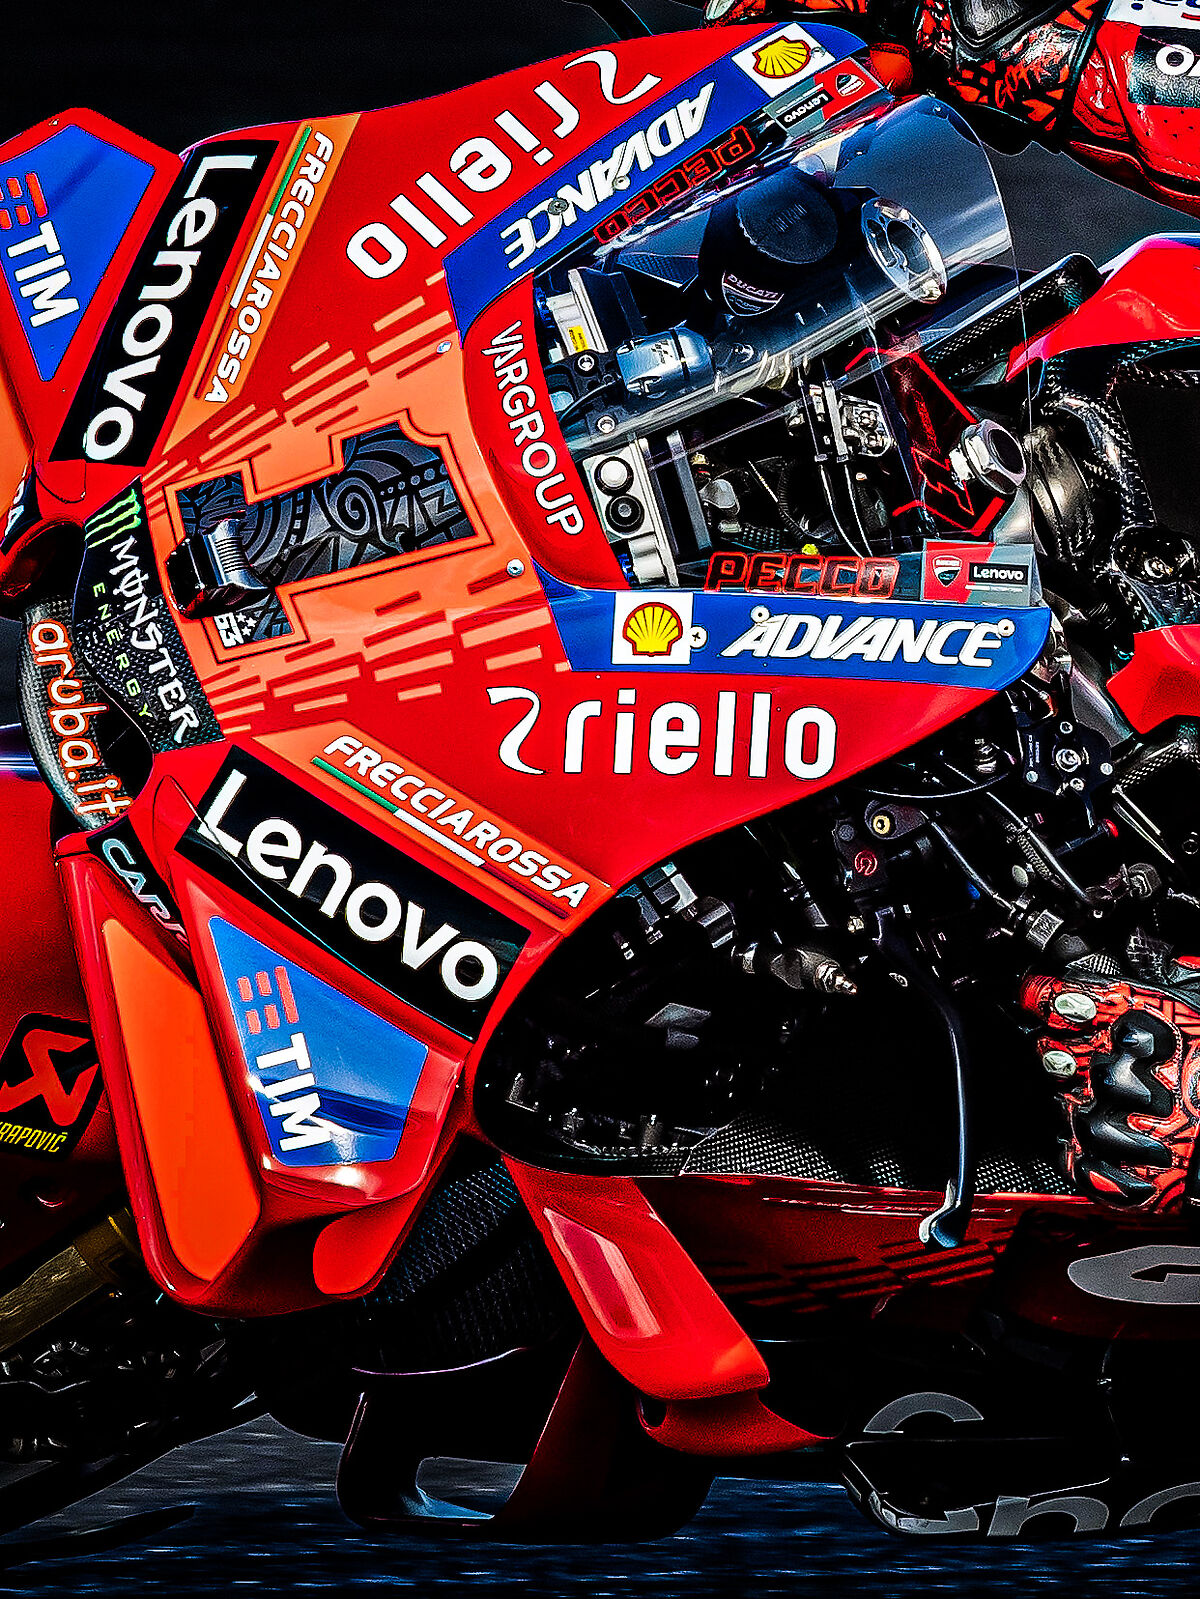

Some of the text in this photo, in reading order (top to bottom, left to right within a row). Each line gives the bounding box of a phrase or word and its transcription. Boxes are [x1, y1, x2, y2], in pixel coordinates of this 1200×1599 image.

[783, 93, 829, 124] Lenovo
[346, 80, 580, 280] riello
[500, 81, 716, 271] ADVANCE
[594, 125, 755, 247] PECCO
[7, 221, 80, 328] TIM
[85, 154, 257, 461] Lenovo
[204, 131, 335, 404] FRECCIAROSSA
[726, 274, 779, 299] DUCATI
[481, 321, 585, 537] VARGROUP
[213, 612, 244, 649] 63
[704, 552, 900, 598] PECCO
[973, 566, 1024, 580] Lenovo
[92, 582, 153, 718] ENERGY
[108, 535, 200, 744] MONSTER
[719, 613, 1001, 668] ADVANCE
[28, 618, 134, 819] aruba.it
[564, 688, 837, 779] riello
[198, 769, 499, 1002] Lenovo
[323, 734, 590, 908] FRECCIAROSSA
[256, 1032, 331, 1152] TIM
